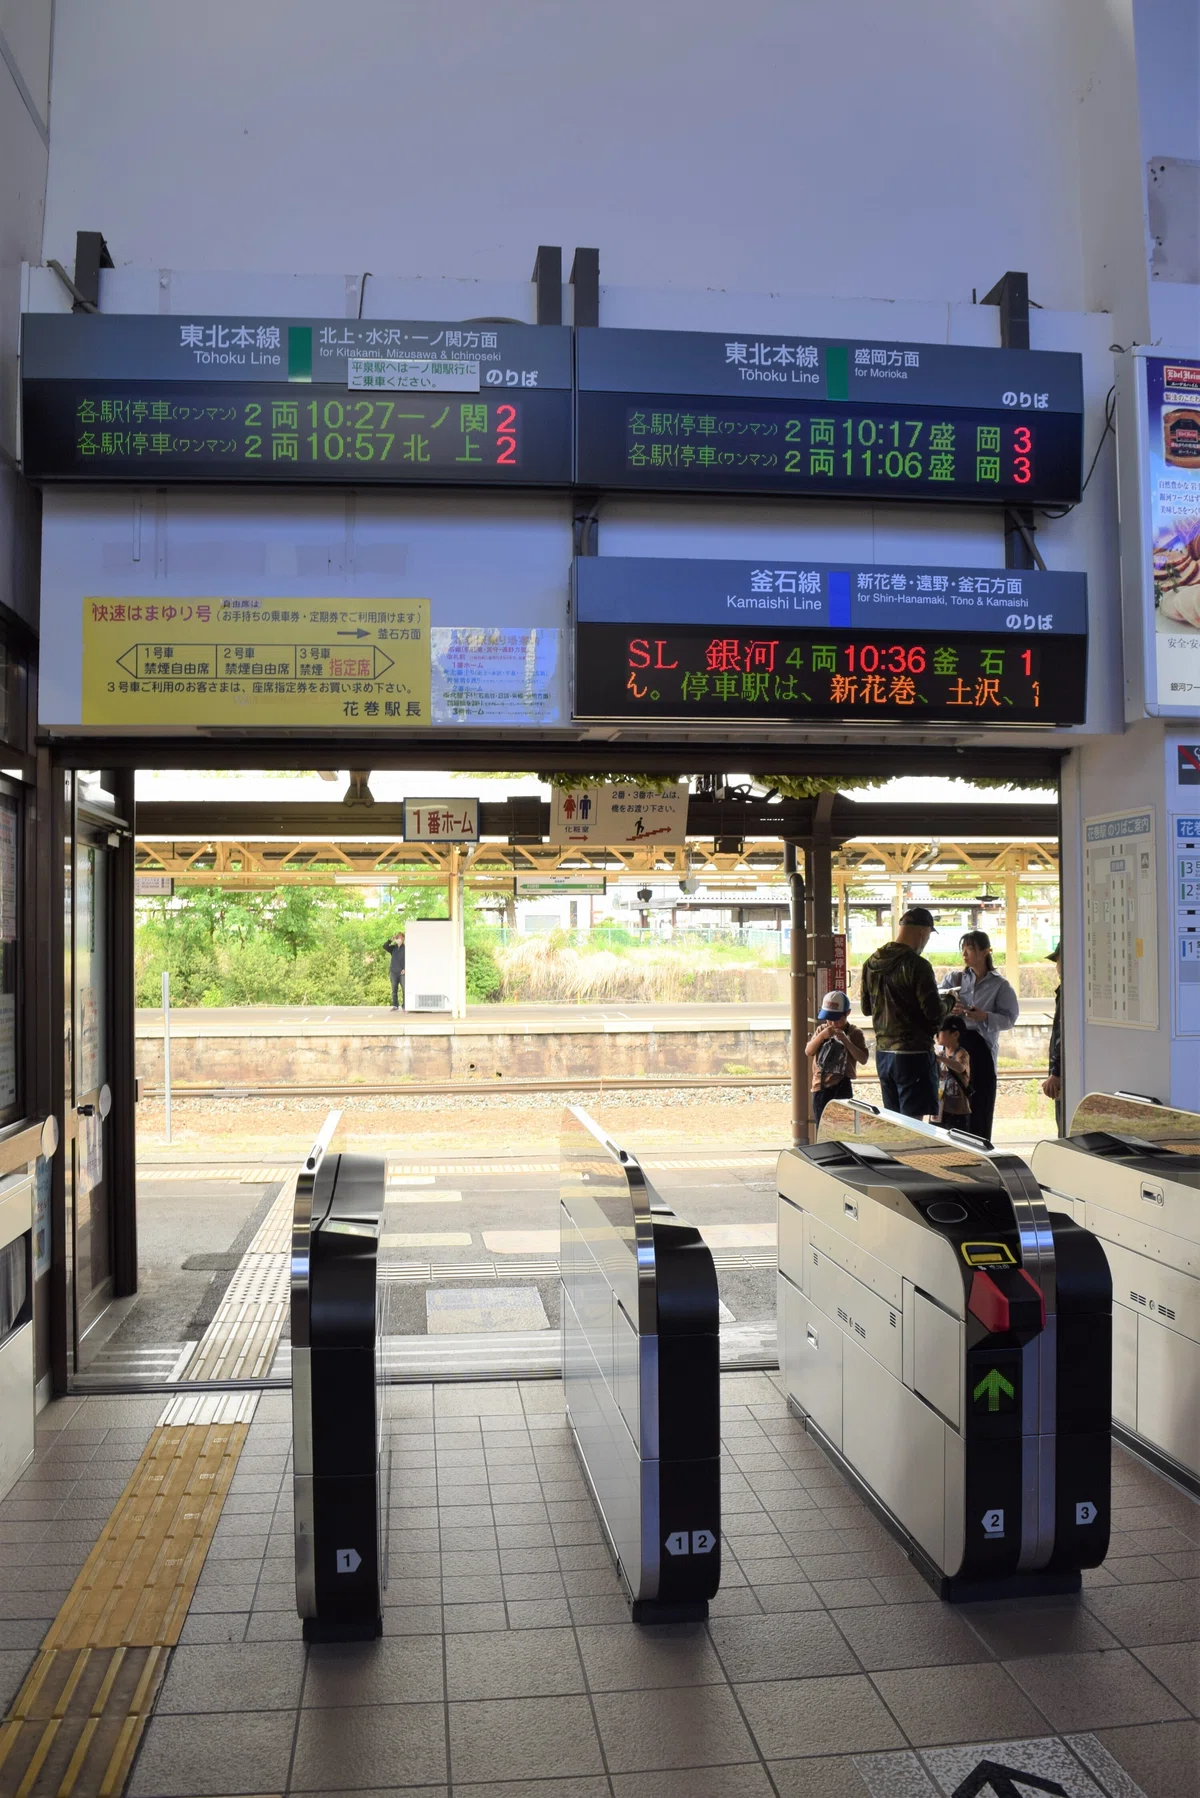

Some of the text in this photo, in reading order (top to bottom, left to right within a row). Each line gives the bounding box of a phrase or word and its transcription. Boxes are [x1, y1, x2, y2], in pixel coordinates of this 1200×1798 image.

[180, 324, 281, 349] 東北本線
[319, 327, 498, 349] 北上・水沢・一ノ関方面
[193, 350, 281, 366] Tōhoku Line
[319, 347, 502, 362] for Kitakami, Mizusawa & Ichinoseki
[725, 342, 819, 368] 東北本線
[854, 349, 920, 367] 盛岡方面
[351, 361, 477, 375] 平泉駅へは一ノ関駅行に
[738, 368, 820, 383] Tōhoku Line
[855, 368, 908, 379] for Morioka
[352, 376, 436, 388] ご乗車ください。
[486, 369, 538, 387] のりば
[1002, 391, 1049, 408] のりば
[306, 400, 395, 429] 10:27
[496, 404, 516, 433] 2
[842, 419, 923, 448] 10:17
[1013, 427, 1032, 454] 3
[306, 432, 395, 461] 10:57
[496, 436, 516, 464] 2
[842, 449, 923, 478] 11:06
[1013, 456, 1032, 483] 3
[1159, 480, 1200, 490] 自然豊かな岩
[1160, 505, 1200, 515] 美味しさをつく
[750, 569, 822, 594] 釜石線
[857, 573, 1023, 595] 新花巻・遠野・釜石方面
[222, 600, 260, 608] 自由席は
[726, 595, 822, 610] Kamaishi Line
[857, 593, 870, 602] for
[872, 594, 948, 606] Shin-Hanamaki,
[976, 597, 984, 606] &
[986, 597, 1029, 608] Kamaishi
[92, 603, 212, 623] 快速はまゆり号
[1006, 614, 1053, 630] のりば
[377, 628, 421, 641] 釜石方面
[1167, 638, 1200, 649] 安全・安
[144, 647, 330, 660] 1号車 2号車 3号車
[628, 639, 679, 668] SL
[705, 639, 780, 672] 銀河
[844, 645, 926, 673] 10:36
[1021, 649, 1032, 676] 1
[144, 658, 371, 677] 禁煙自由席 禁煙自由席 禁煙 指定席
[343, 701, 421, 717] 花巻駅長
[611, 804, 676, 813] 橋をお渡り下さい。
[412, 808, 474, 834] 1番ホーム
[1186, 862, 1193, 874] 3
[1186, 885, 1194, 897] 2
[1188, 942, 1193, 953] 1
[834, 937, 845, 989] 緊急停止用
[1081, 1506, 1090, 1519] 3
[991, 1514, 1000, 1527] 2
[675, 1535, 708, 1550] 1 2
[343, 1553, 351, 1568] 1
